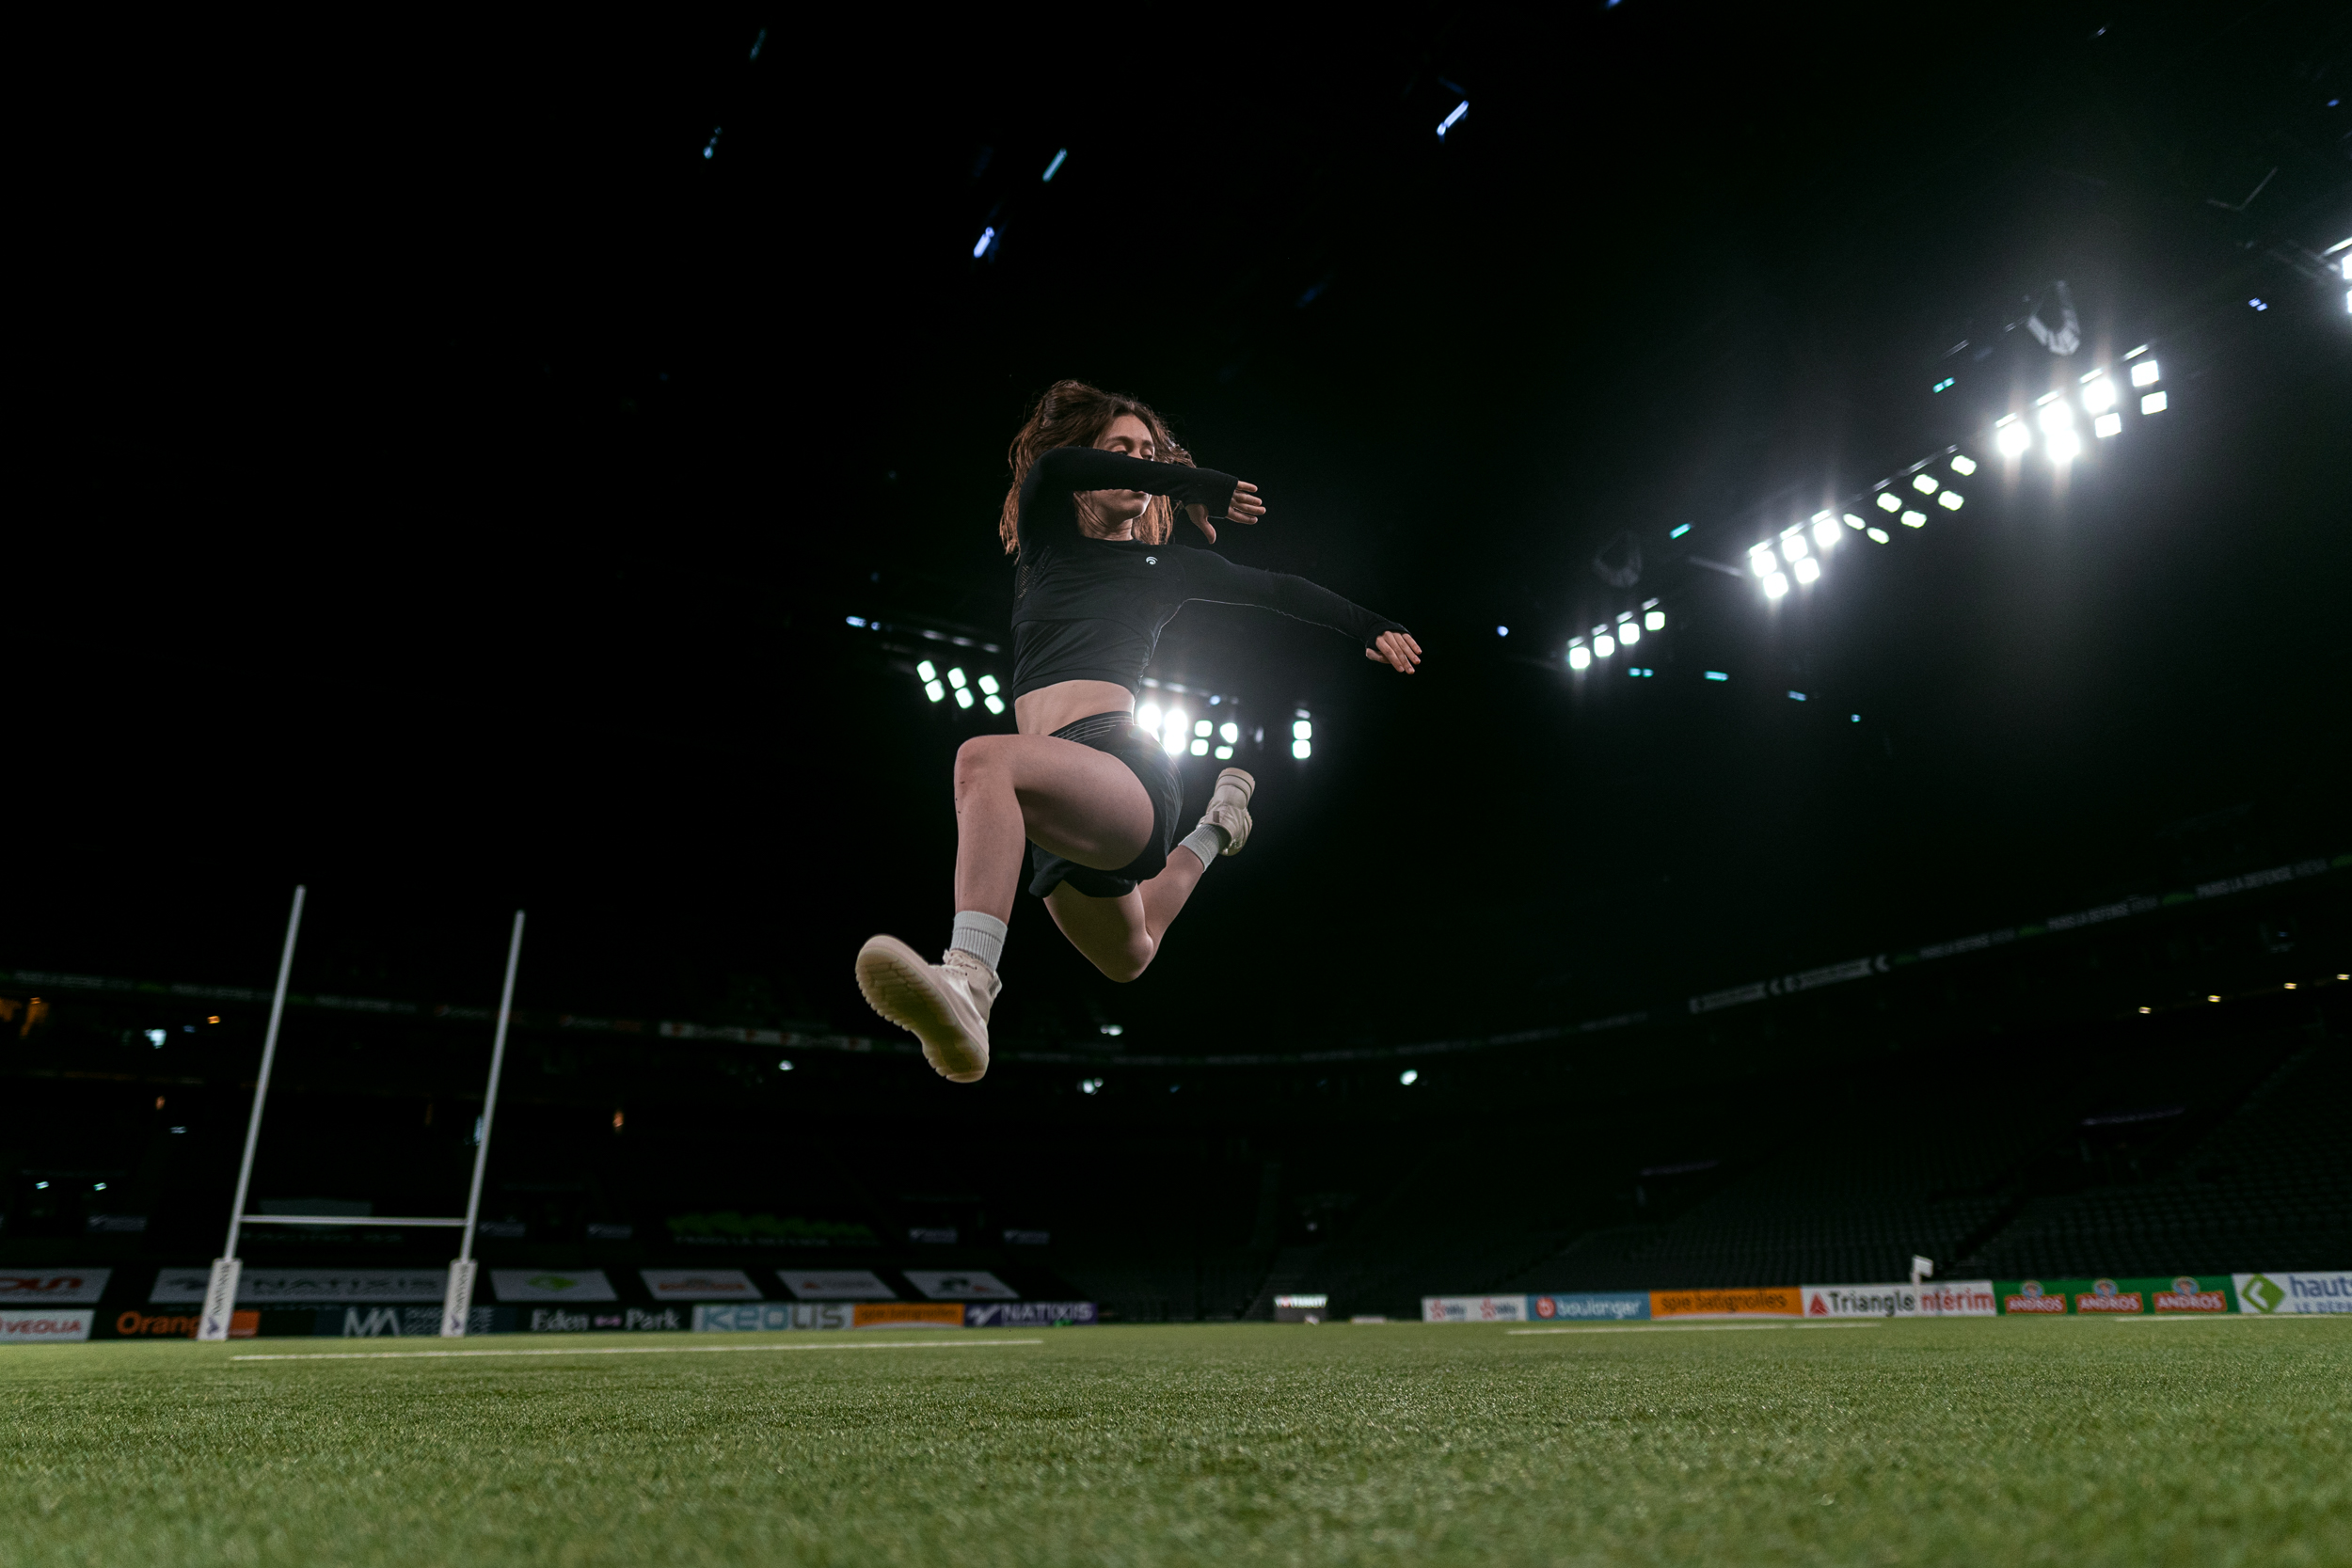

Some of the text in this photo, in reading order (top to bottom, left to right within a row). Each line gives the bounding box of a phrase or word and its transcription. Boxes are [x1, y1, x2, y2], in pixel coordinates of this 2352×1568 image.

[1557, 1298, 1641, 1319] boulanger
[1829, 1288, 1994, 1317] Triangle ntérim
[2009, 1298, 2063, 1311] ANDROS
[2080, 1297, 2138, 1310] ANDROS
[2157, 1295, 2222, 1309] ANDROS
[531, 1307, 679, 1331] Eden Park
[1001, 1303, 1093, 1321] NATIXIS
[7, 1320, 81, 1334] VEOLIA
[115, 1310, 199, 1338] Orang
